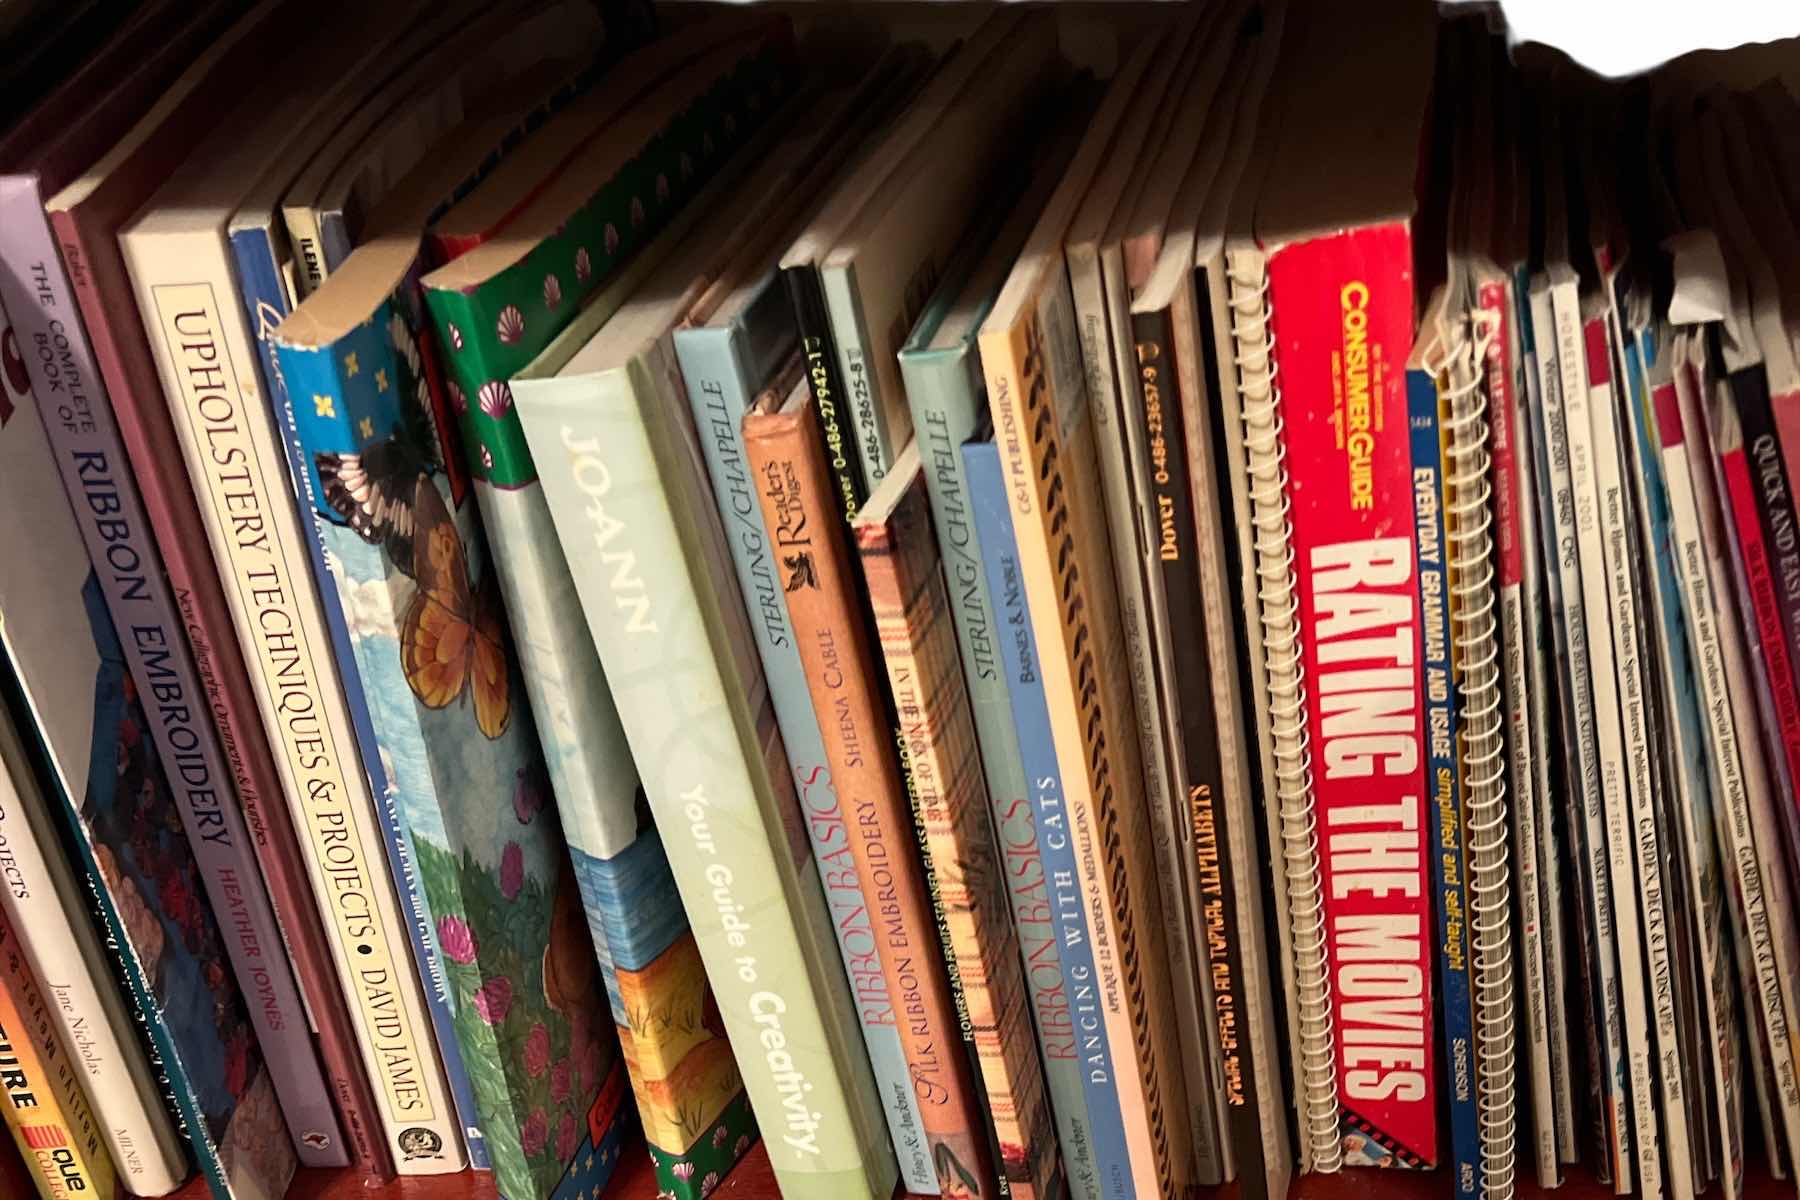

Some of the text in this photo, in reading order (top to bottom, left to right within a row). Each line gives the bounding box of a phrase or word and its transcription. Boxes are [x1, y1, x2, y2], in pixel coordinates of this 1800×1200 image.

[300, 237, 322, 282] ILENE
[31, 261, 97, 433] THE COMPLETE
[1560, 311, 1582, 413] HOMESTYLE
[33, 331, 78, 435] BOOK OF
[173, 307, 271, 555] UPHOLSTERY
[761, 459, 812, 549] Reader's
[839, 473, 858, 524] Dover
[1753, 433, 1786, 506] QUICK
[700, 379, 790, 649] STERLING/CHAPELLE
[1157, 493, 1179, 561] Dover
[1606, 487, 1621, 526] Better
[1769, 507, 1797, 560] AND
[924, 407, 998, 681] STERLING/CHAPELLE
[1610, 528, 1625, 573] Homes
[1685, 539, 1701, 584] Better
[1001, 555, 1020, 608] NOBLE
[1614, 573, 1629, 598] and
[1691, 578, 1707, 620] Homes
[72, 449, 233, 848] RIBBON EMBROIDERY
[1012, 621, 1036, 685] BARNES
[1568, 602, 1585, 649] HOUSE
[1698, 619, 1715, 645] and
[246, 563, 330, 770] TECHNIQUES
[816, 627, 864, 768] SHEENA CABLE
[1573, 650, 1593, 719] BEAUTIFUL
[1621, 658, 1639, 699] Special
[1413, 466, 1466, 971] EVERYDAY GRAMMAR AND USAGE simplified and self-taught
[1629, 699, 1643, 743] Interest
[1710, 697, 1730, 736] Special
[1630, 744, 1649, 810] Publications
[1719, 734, 1738, 775] Interest
[306, 778, 337, 803] &
[1035, 775, 1067, 850] CATS
[1309, 536, 1428, 1104] RATING THE MOVIES
[1605, 760, 1626, 867] PRETTY TERRIFIC
[1727, 776, 1747, 839] Publications
[315, 810, 377, 938] PROJECTS
[852, 797, 909, 950] EMBROIDERY
[1190, 784, 1222, 896] ALPHABETS
[1639, 816, 1661, 887] GARDEN,
[680, 783, 717, 856] Your
[705, 863, 752, 948] Guide
[735, 956, 758, 985] to
[796, 764, 897, 1027] RIBBON BASICS
[1053, 870, 1085, 948] WITH
[1646, 887, 1665, 930] DECK
[1738, 845, 1762, 912] GARDEN,
[217, 866, 260, 958] HEATHER
[248, 966, 287, 1032] JOYNES
[997, 798, 1079, 1061] RIBBON BASICS
[1650, 933, 1662, 944] &
[1750, 909, 1771, 951] DECK
[1758, 948, 1772, 963] &
[49, 983, 102, 1076] Jane Nicholas
[893, 955, 932, 1037] RIBBON
[1070, 963, 1110, 1085] DANCING
[360, 966, 418, 1112] DAVID JAMES
[908, 1041, 949, 1106] SILK
[112, 1127, 145, 1175] MILNER
